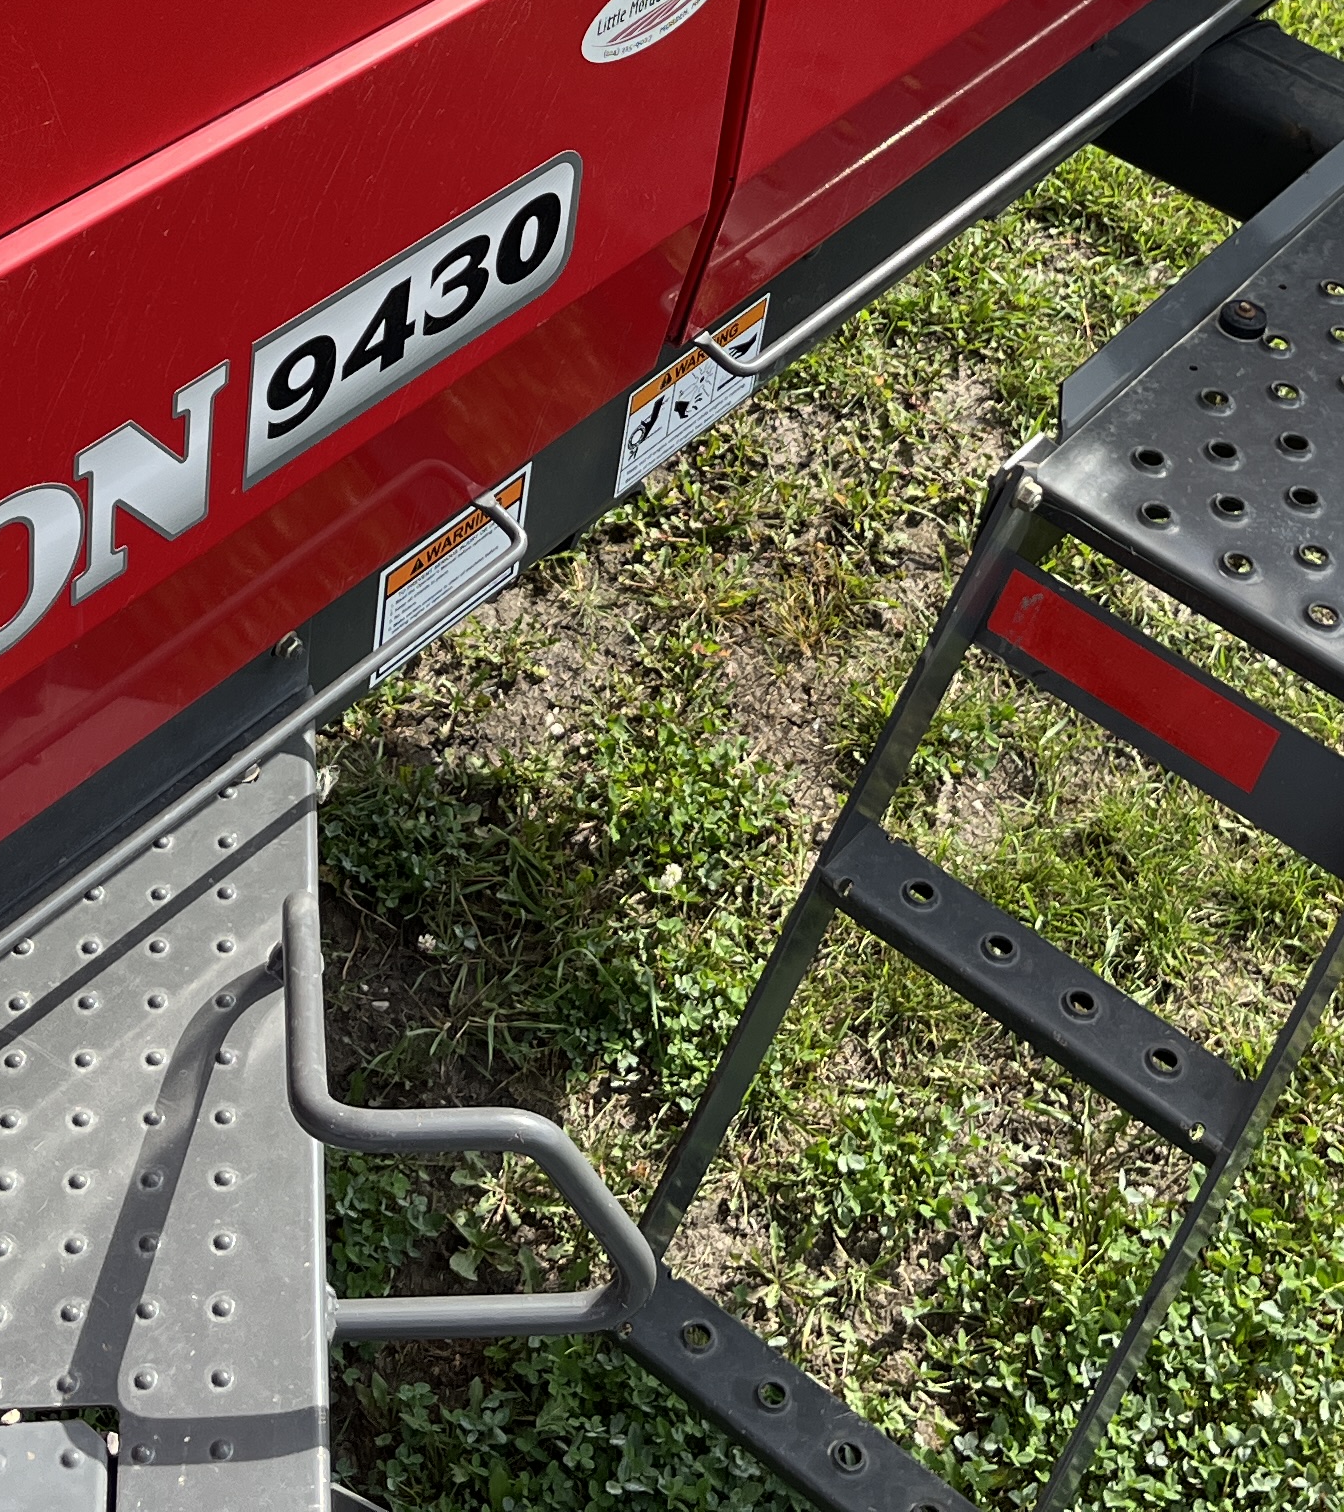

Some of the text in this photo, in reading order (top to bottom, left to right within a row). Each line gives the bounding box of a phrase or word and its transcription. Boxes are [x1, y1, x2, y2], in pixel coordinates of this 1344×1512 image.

[596, 8, 627, 36] Little
[266, 192, 561, 439] 9430
[675, 322, 739, 381] WARING
[425, 496, 503, 564] WARNI
